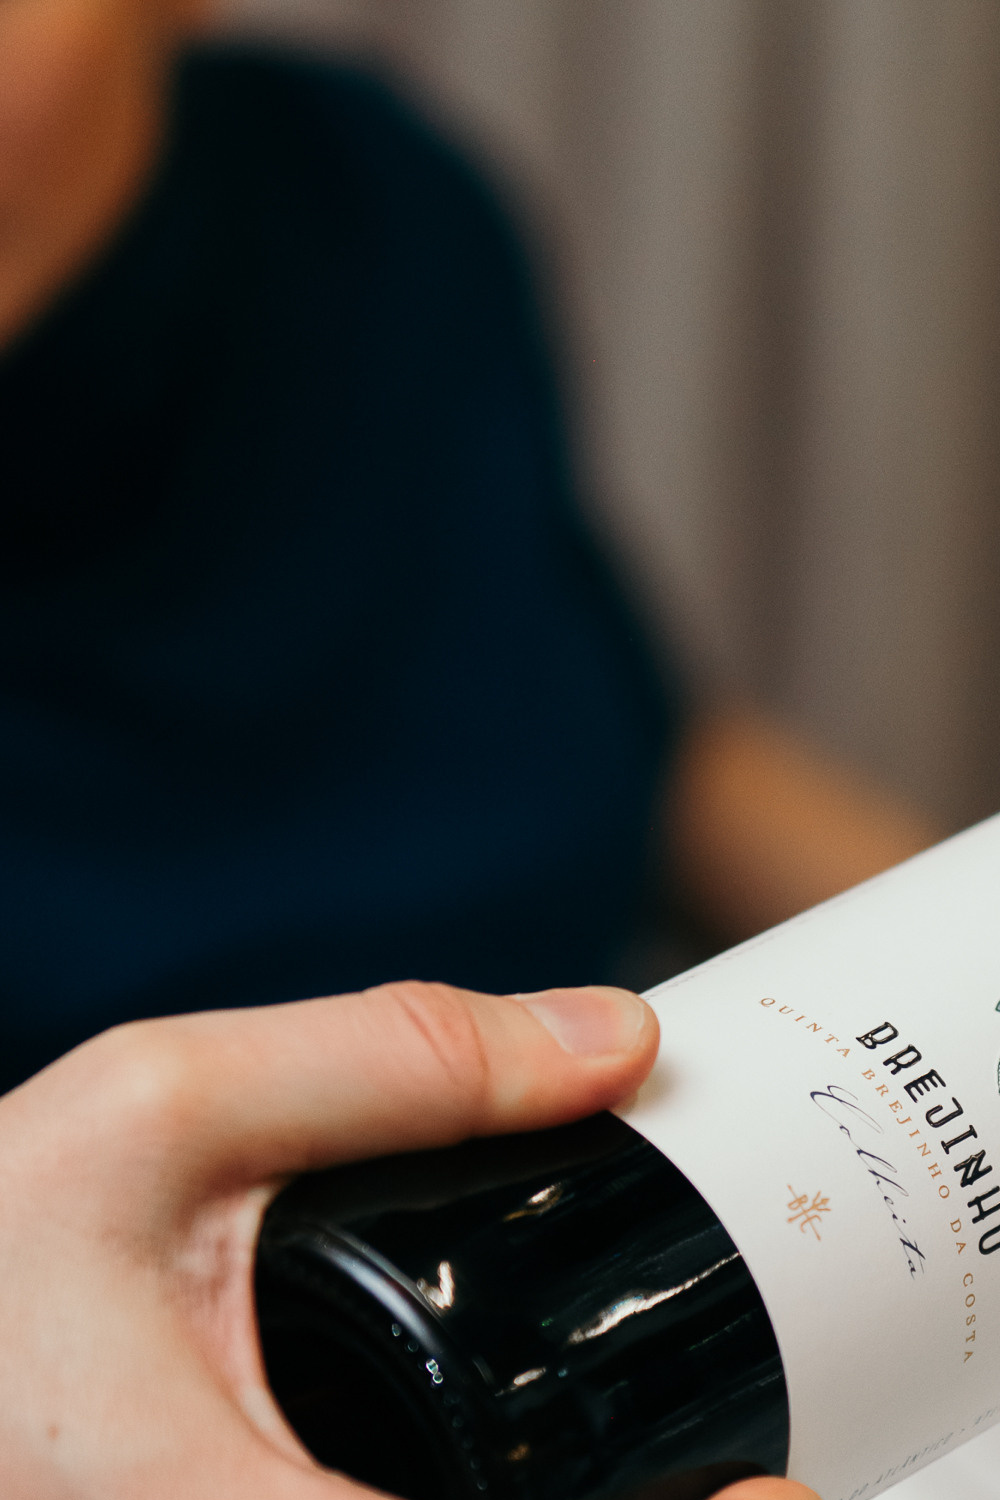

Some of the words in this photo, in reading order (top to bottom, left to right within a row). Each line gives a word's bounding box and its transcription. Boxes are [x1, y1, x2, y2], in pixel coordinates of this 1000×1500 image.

[759, 996, 851, 1059] QUINTA
[861, 1067, 951, 1201] BREJINHO
[949, 1217, 967, 1255] DA
[962, 1272, 977, 1364] COSTA
[809, 1084, 926, 1281] Colheita
